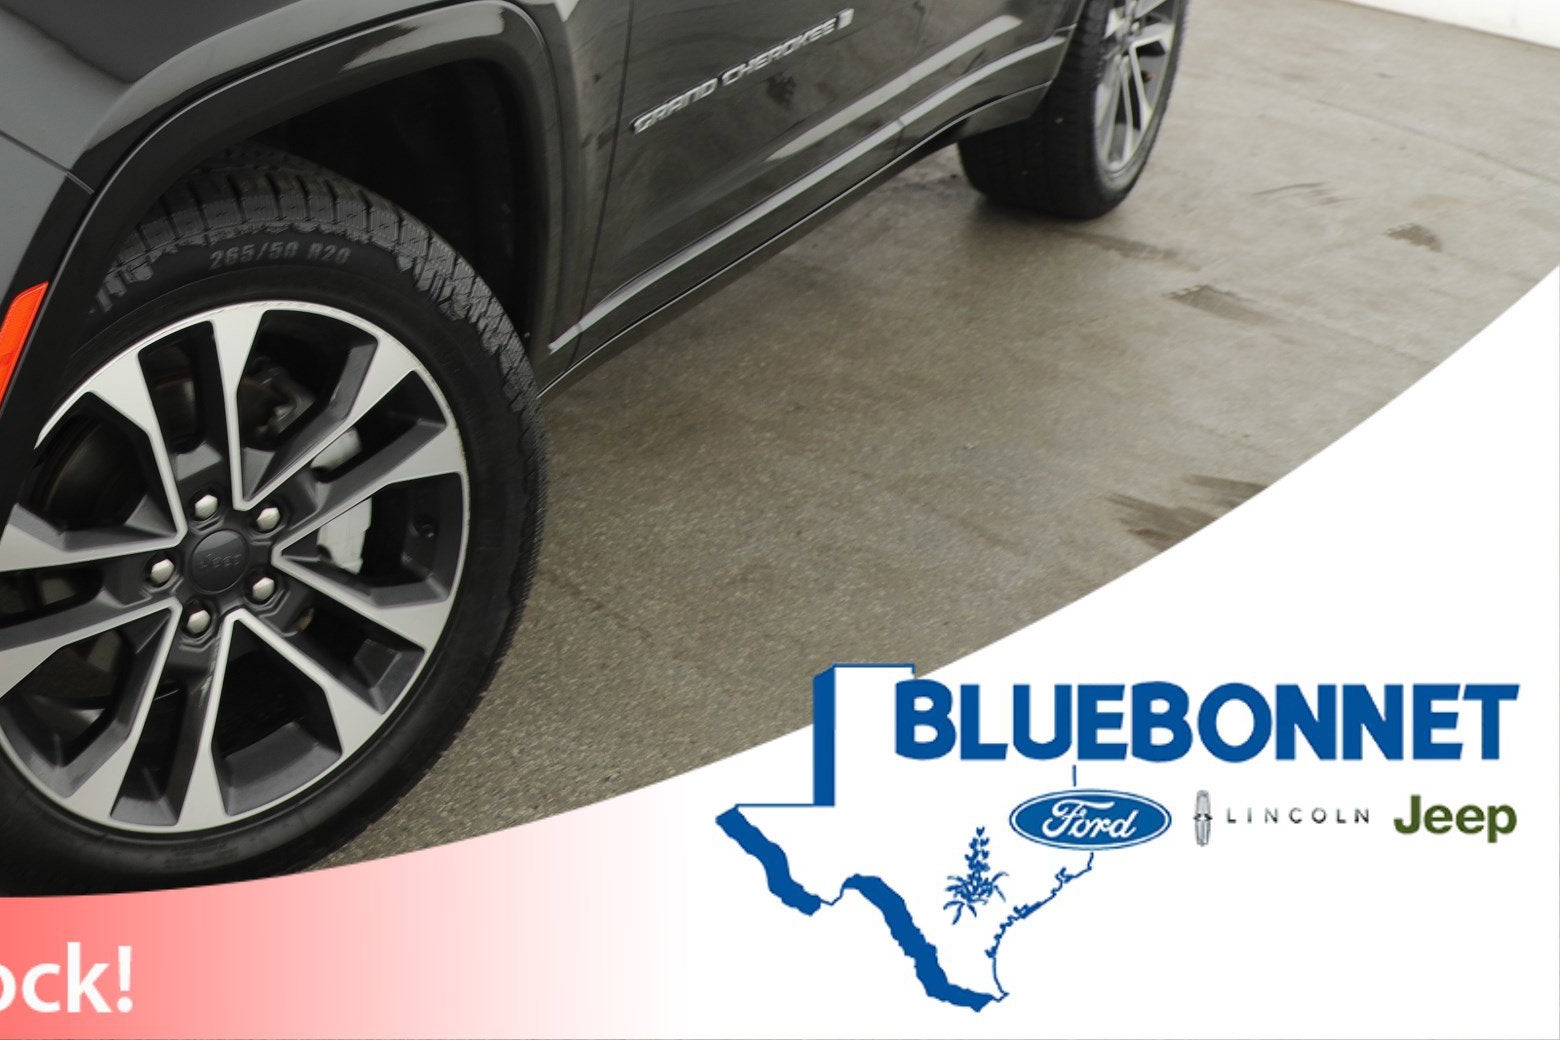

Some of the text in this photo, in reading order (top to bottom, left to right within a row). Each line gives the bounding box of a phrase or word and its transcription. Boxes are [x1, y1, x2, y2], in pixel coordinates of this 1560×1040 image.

[633, 17, 837, 135] GRAND CHEROKEE
[209, 240, 352, 270] 265/50 R20
